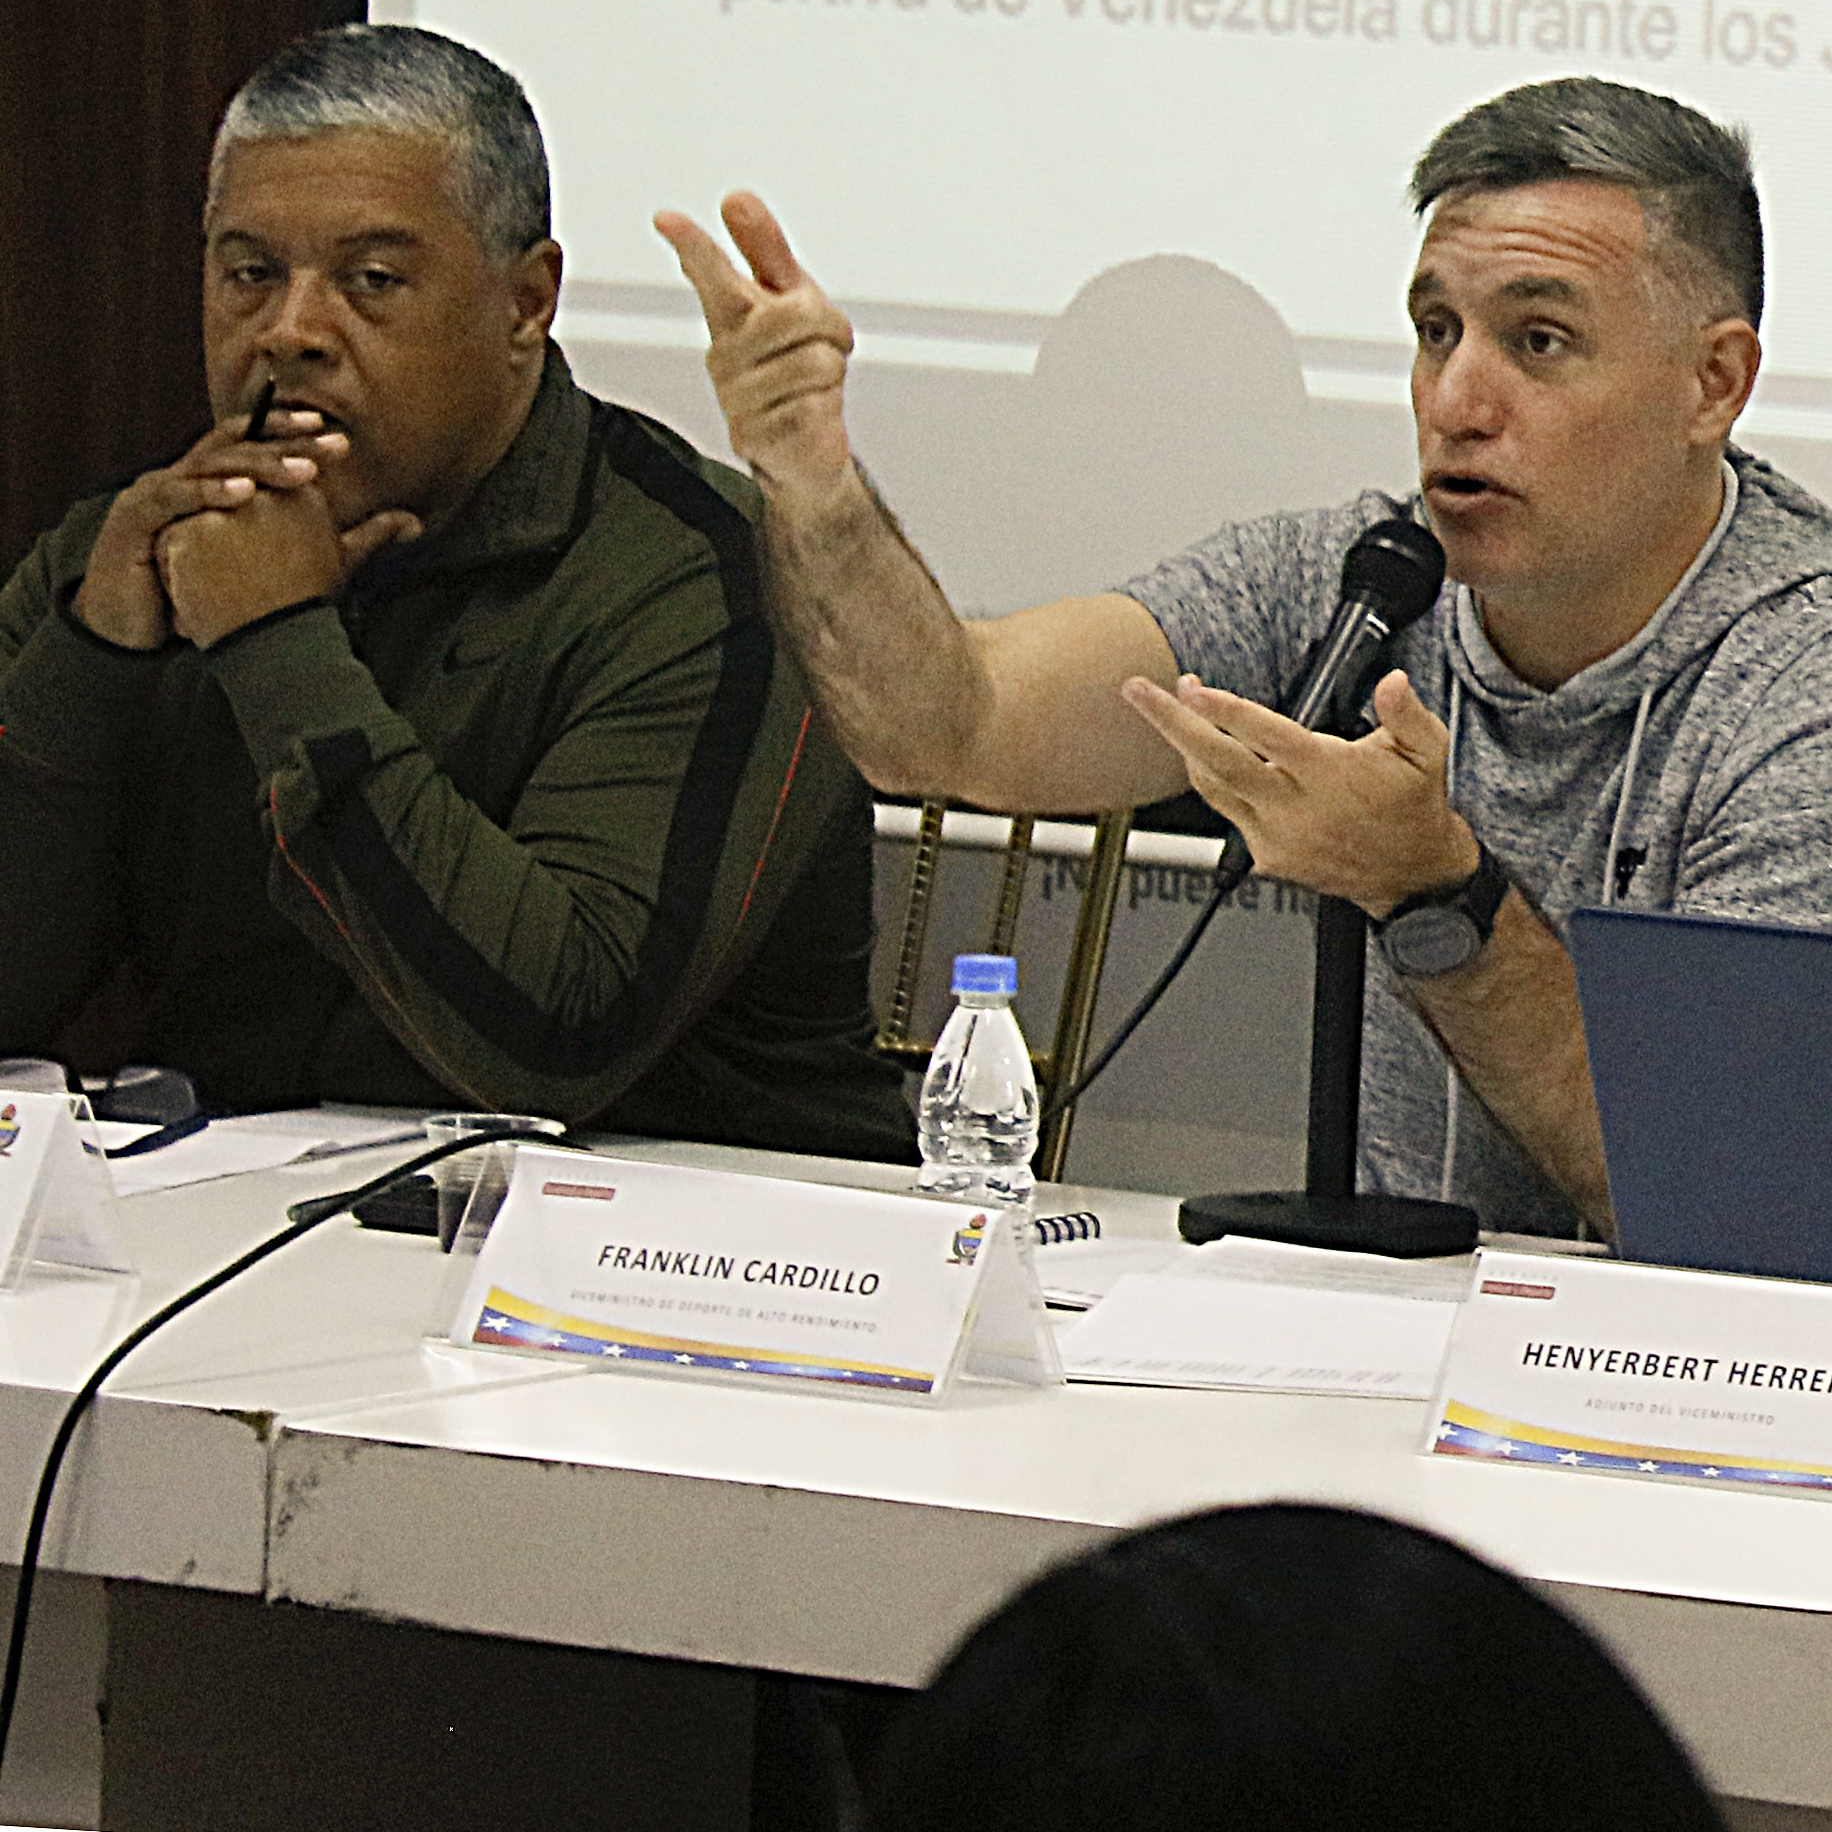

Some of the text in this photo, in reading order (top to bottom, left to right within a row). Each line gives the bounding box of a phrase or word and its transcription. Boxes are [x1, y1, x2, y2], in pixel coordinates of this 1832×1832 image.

[1129, 866, 1261, 910] puee
[597, 1244, 880, 1297] FRANKLIN CARDILLO
[659, 1299, 673, 1311] DE
[738, 1308, 753, 1320] DE
[757, 1310, 787, 1322] ALTO
[1522, 1342, 1719, 1383] HENYERBERT
[1678, 1406, 1776, 1426] VICEMINISTRO
